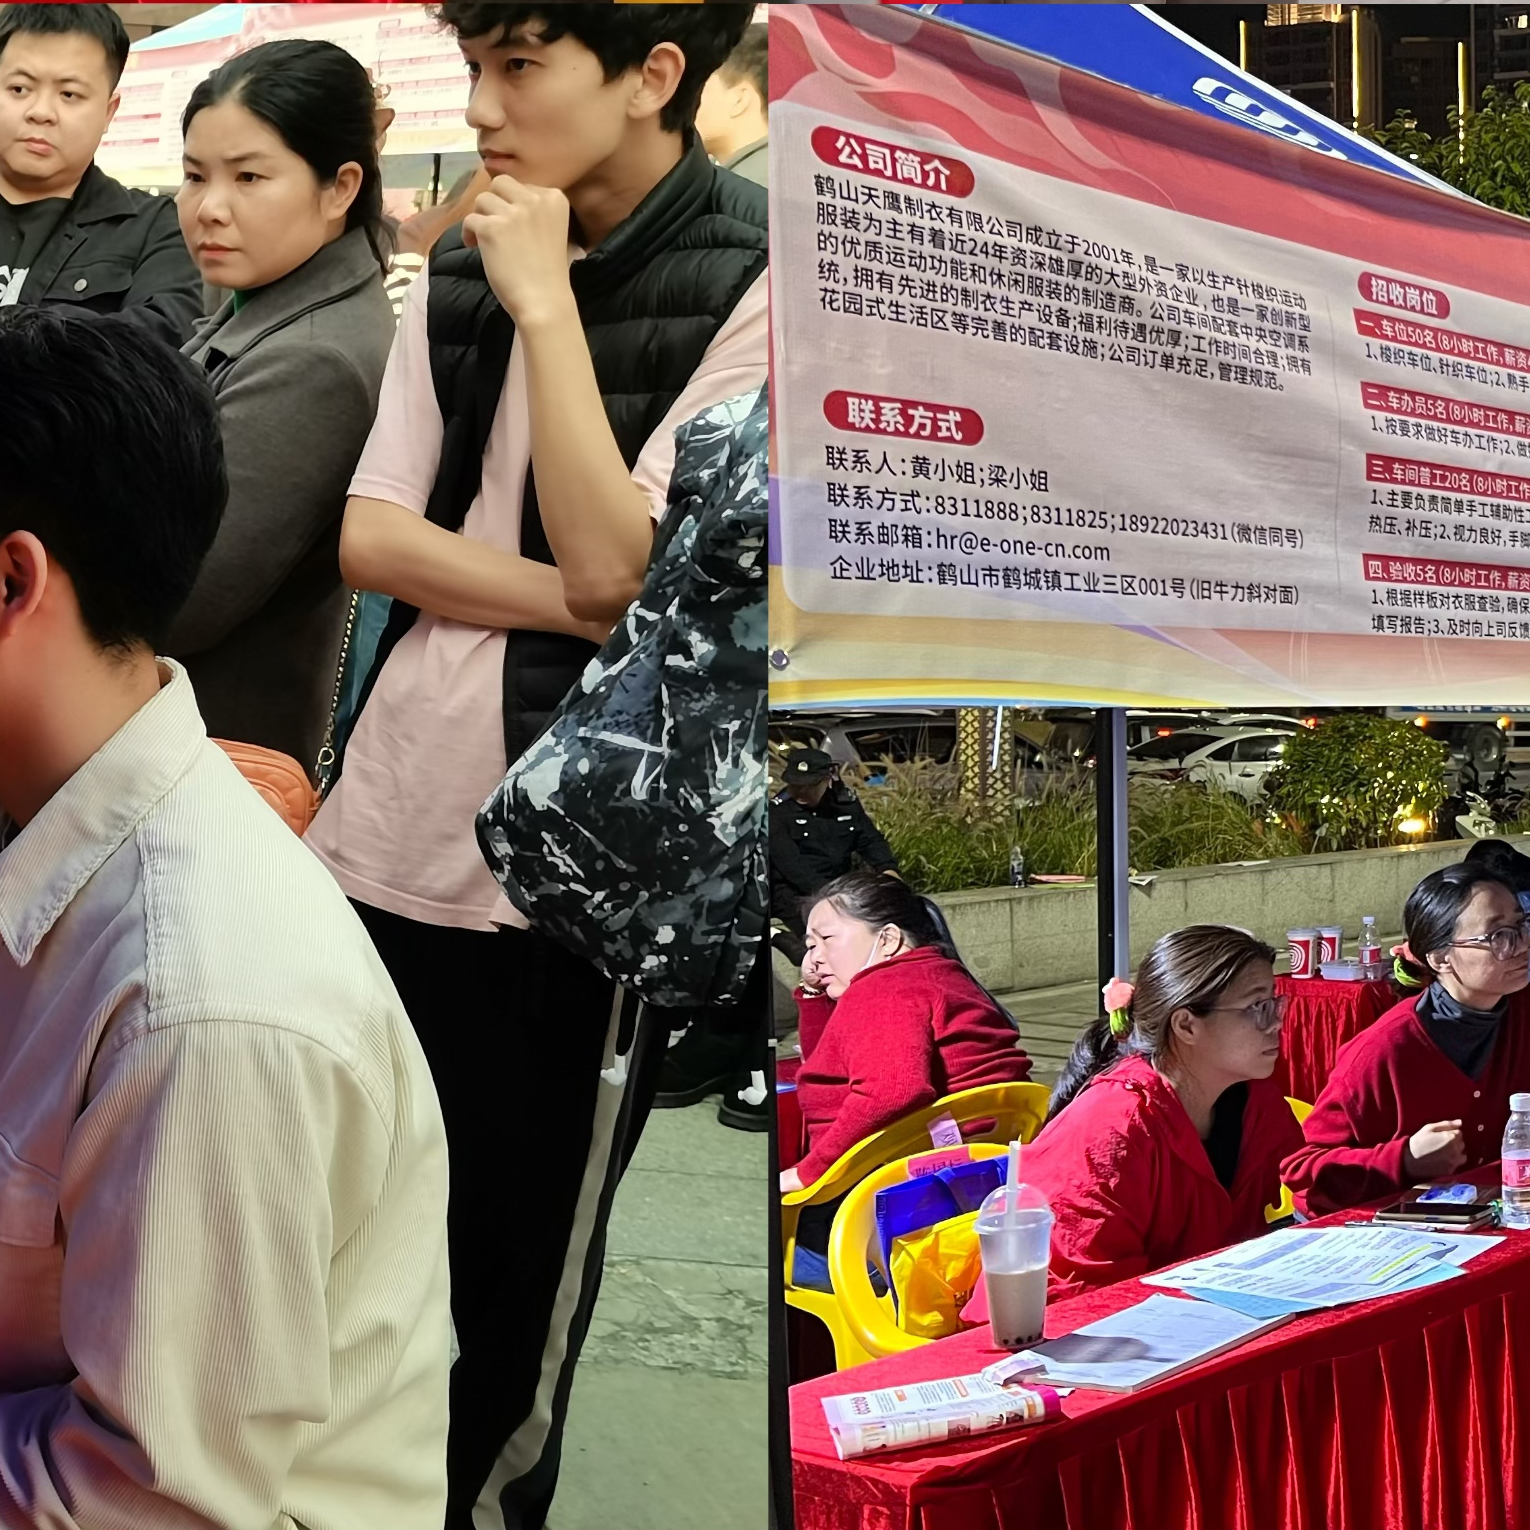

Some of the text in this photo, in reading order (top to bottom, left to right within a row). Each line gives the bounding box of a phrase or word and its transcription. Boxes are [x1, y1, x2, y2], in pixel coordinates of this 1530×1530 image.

[834, 135, 951, 191] 公司简介
[1370, 276, 1438, 315] 招收岗位
[846, 396, 963, 442] 联系方式
[825, 445, 1049, 493] 联系人:黄小姐;梁小姐
[826, 482, 1305, 549] 联系方式:8311888;8311825;18922023431(微信同号)
[827, 518, 1110, 562] 联系邮箱:hr@e-one-cn.com
